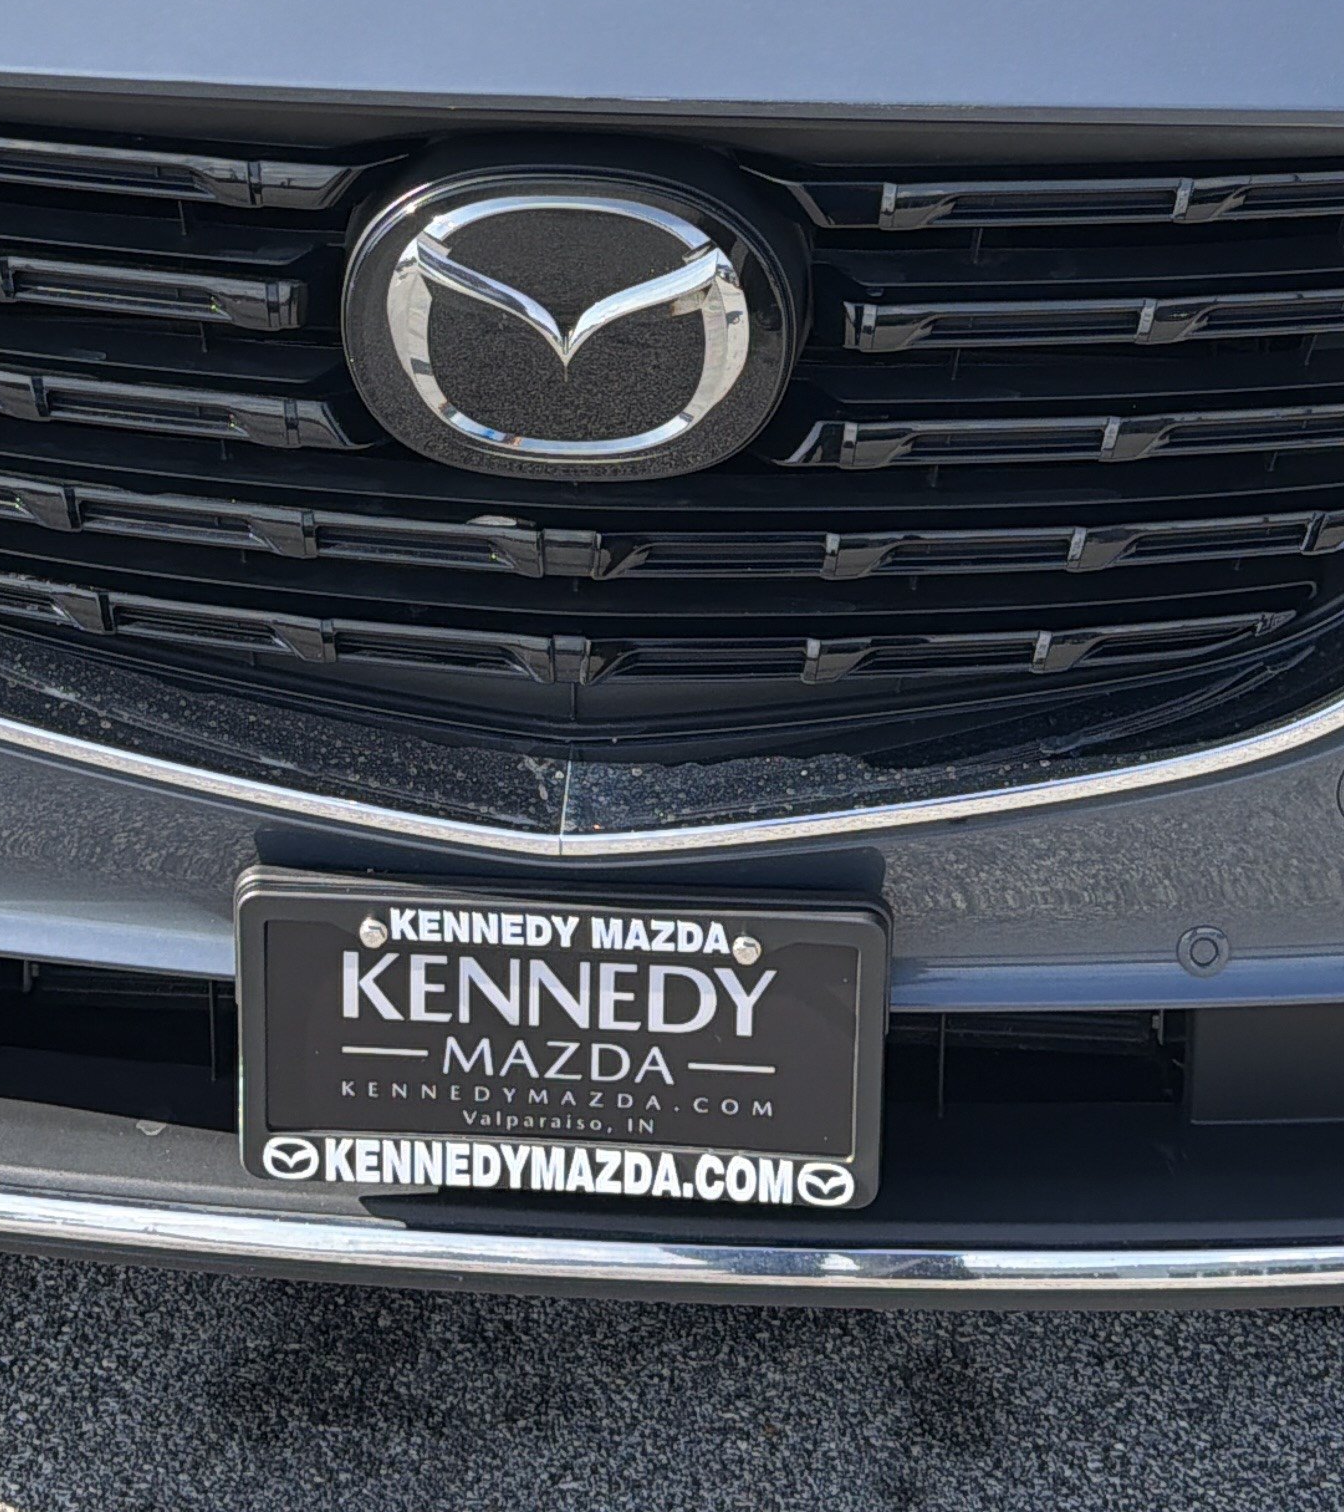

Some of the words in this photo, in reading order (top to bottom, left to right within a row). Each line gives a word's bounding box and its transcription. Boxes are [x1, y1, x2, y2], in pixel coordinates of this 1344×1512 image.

[390, 907, 579, 948] KENNEDY
[591, 916, 731, 955] MAZDA
[341, 950, 778, 1037] KENNEDY
[442, 1035, 675, 1086] MAZDA
[340, 1080, 774, 1118] KENNEDYMAZDA.COM
[462, 1109, 613, 1134] Valparaiso,
[628, 1117, 655, 1134] IN
[325, 1138, 794, 1205] KENNEDYMAZDA.COM
